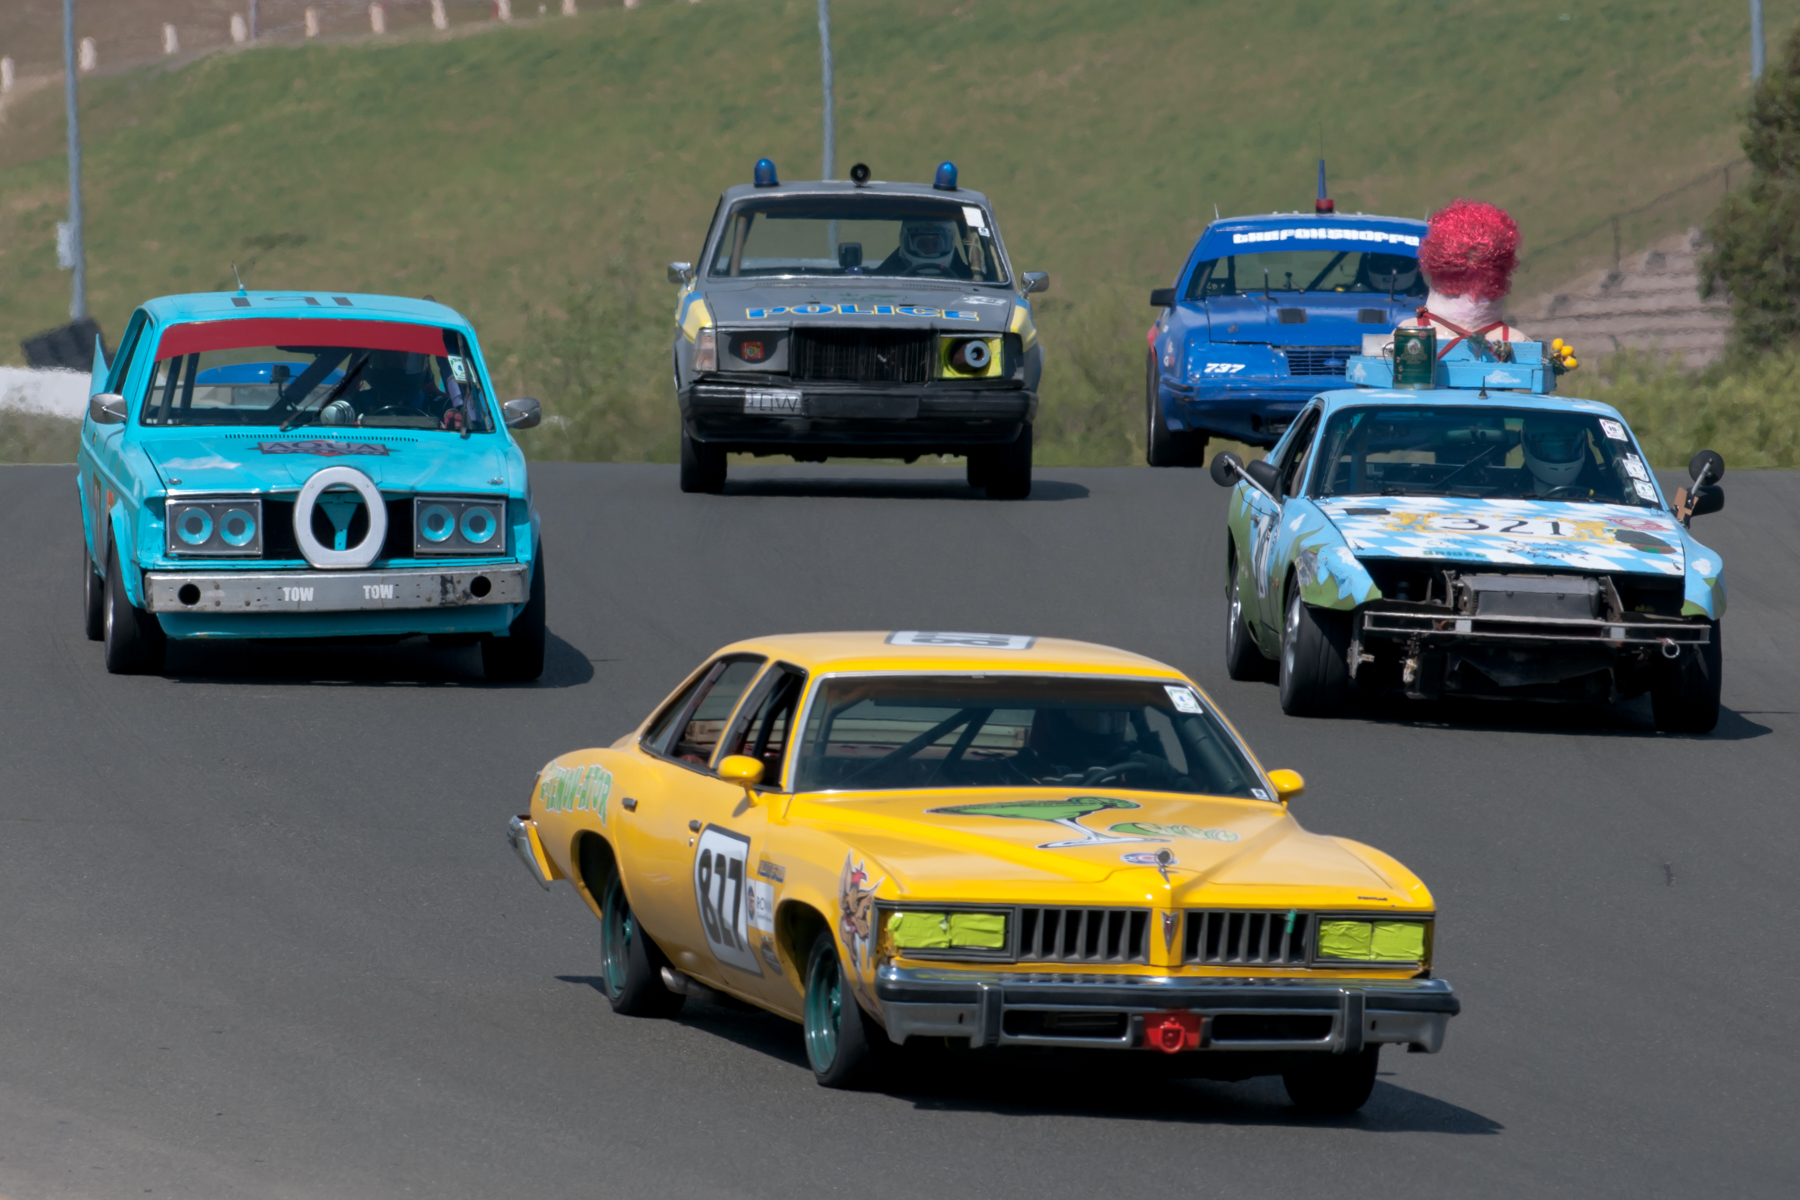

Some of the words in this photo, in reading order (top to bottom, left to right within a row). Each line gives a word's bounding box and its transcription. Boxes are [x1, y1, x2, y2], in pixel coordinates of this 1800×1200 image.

[745, 303, 980, 322] POLICE
[1203, 362, 1246, 374] 737
[268, 441, 380, 451] AQUA
[1439, 516, 1567, 537] 321
[282, 586, 315, 602] TOW
[362, 584, 394, 600] TOW
